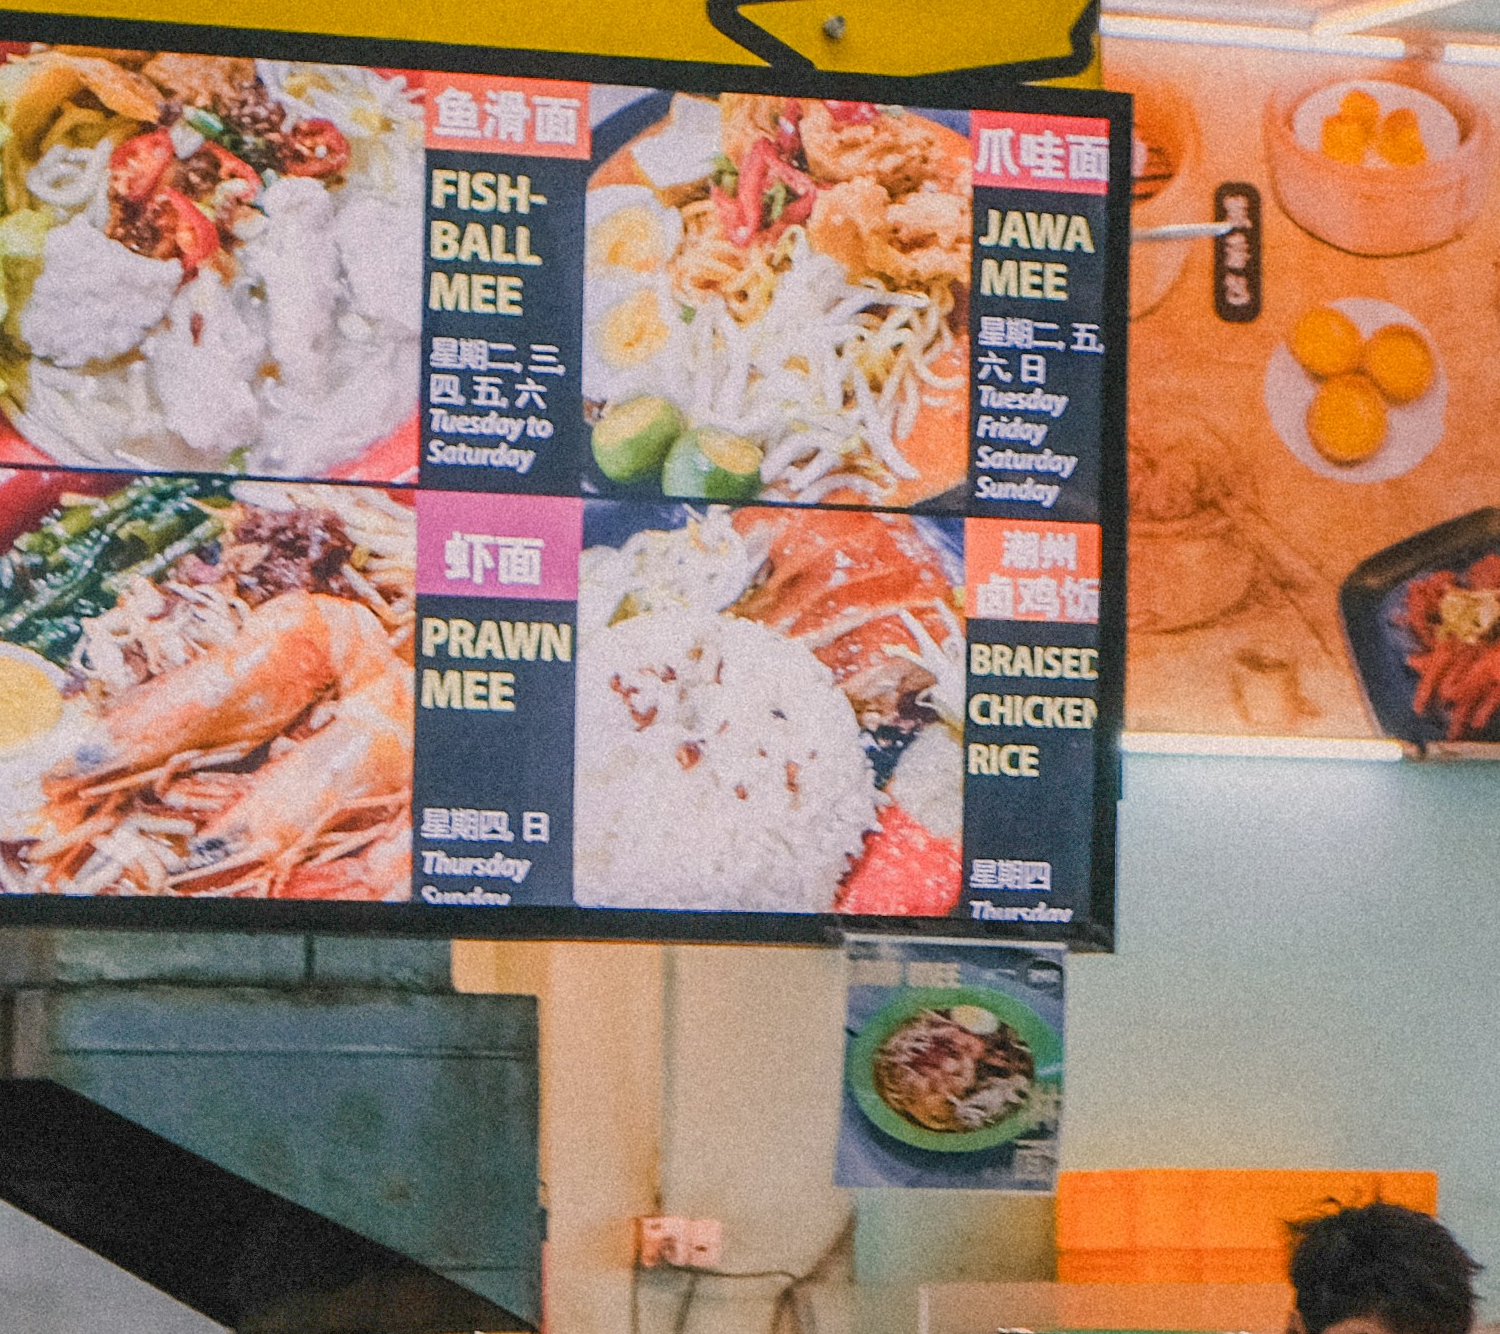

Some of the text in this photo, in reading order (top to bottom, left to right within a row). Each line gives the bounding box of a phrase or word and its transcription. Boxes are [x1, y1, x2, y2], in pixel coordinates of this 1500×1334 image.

[974, 126, 1110, 182] 爪哇面
[430, 168, 548, 215] FISH-
[429, 219, 543, 267] BALL
[978, 208, 1095, 254] JAWA
[427, 270, 525, 317] MEE
[979, 258, 1069, 302] MEE
[977, 384, 1069, 419] Tuesday
[426, 407, 555, 442] Tuesday to
[975, 415, 1048, 448] Friday
[426, 439, 537, 475] Saturday
[975, 445, 1078, 480] Saturday
[975, 475, 1060, 509] Sunday
[443, 531, 545, 586] 虾面
[420, 616, 573, 663] PRAWN
[420, 668, 516, 712] MEE
[968, 742, 1041, 778] RICE
[420, 849, 533, 883] Thursday
[969, 858, 1052, 892] 星期四
[969, 899, 1074, 924] Thursday
